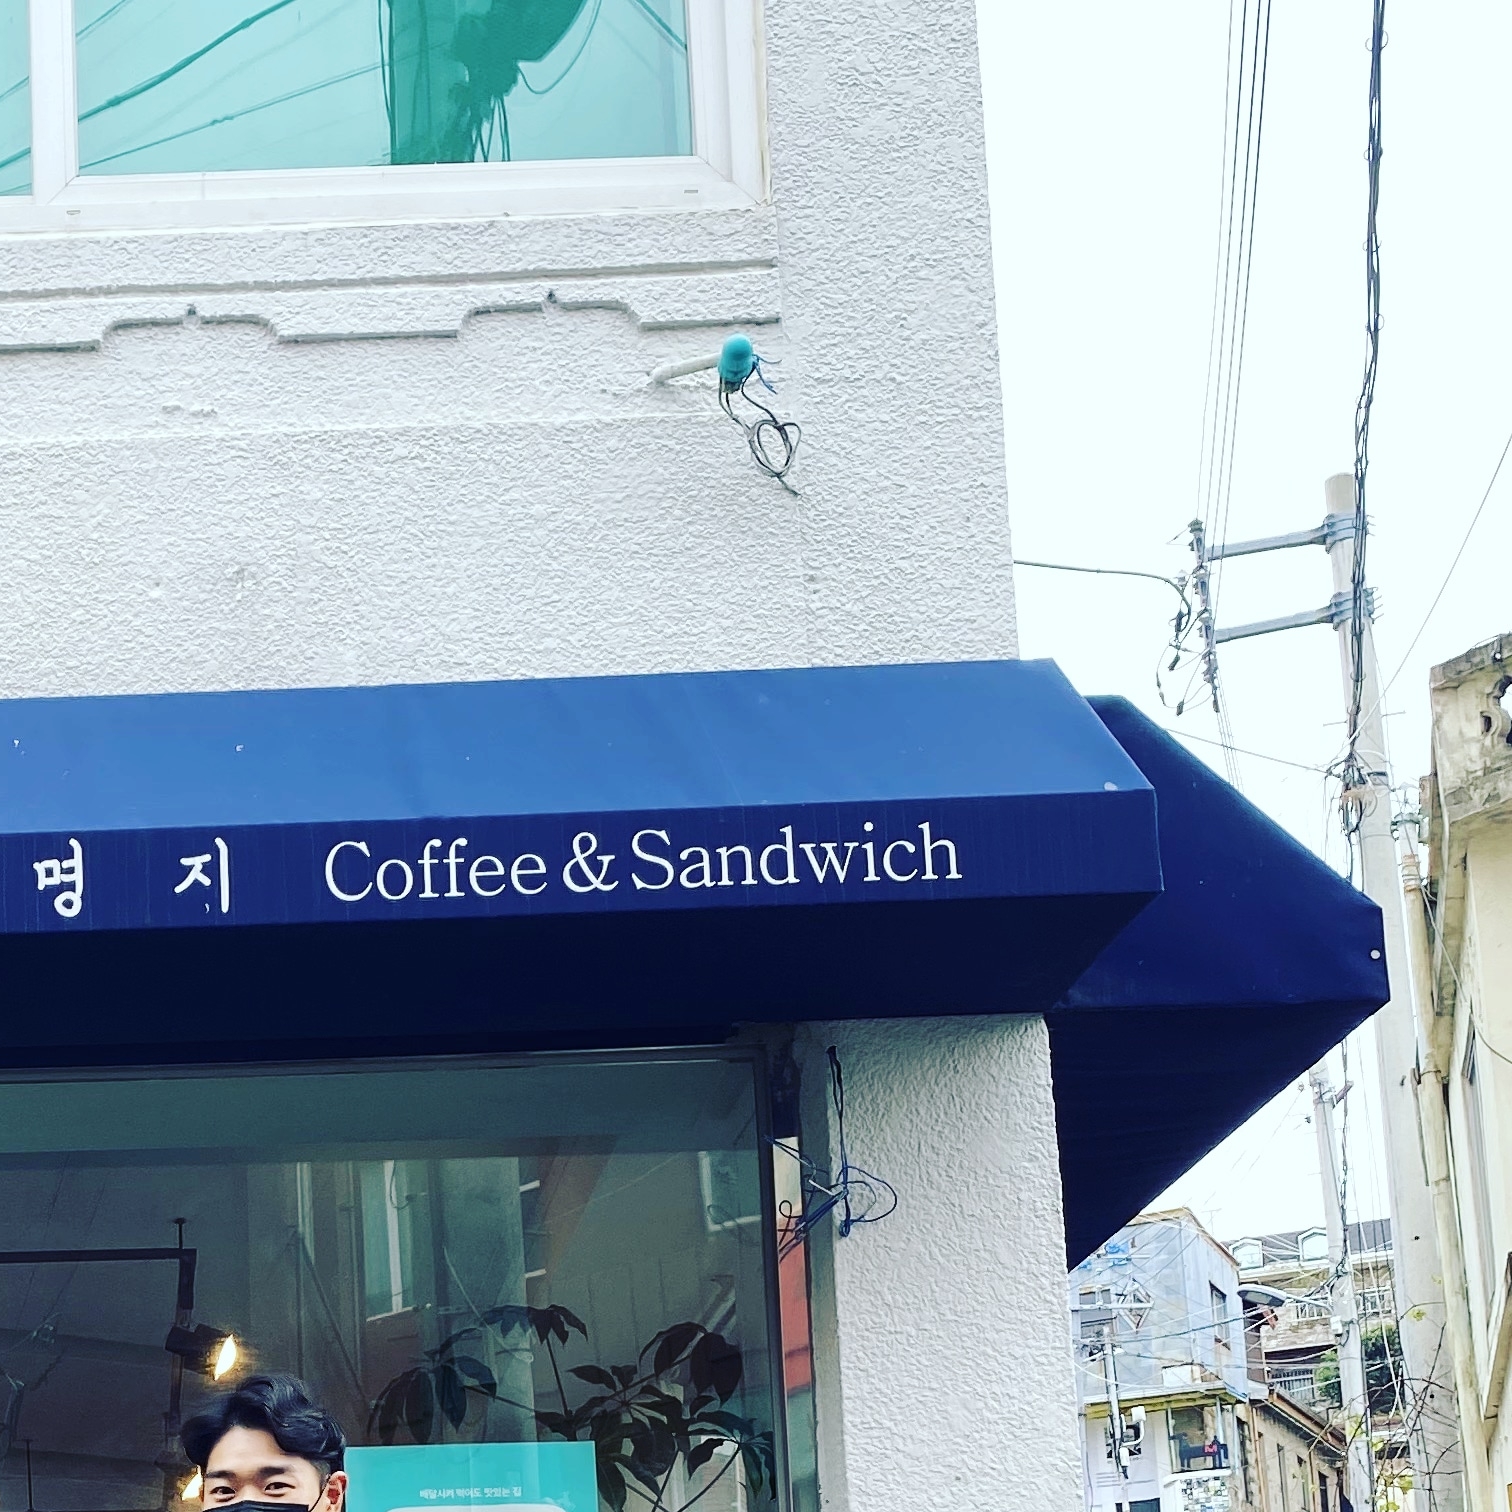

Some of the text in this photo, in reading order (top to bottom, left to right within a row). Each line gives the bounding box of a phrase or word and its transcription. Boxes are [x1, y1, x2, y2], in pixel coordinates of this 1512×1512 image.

[324, 837, 548, 902] Coffee
[561, 831, 619, 893] &
[629, 821, 963, 891] Sandwich
